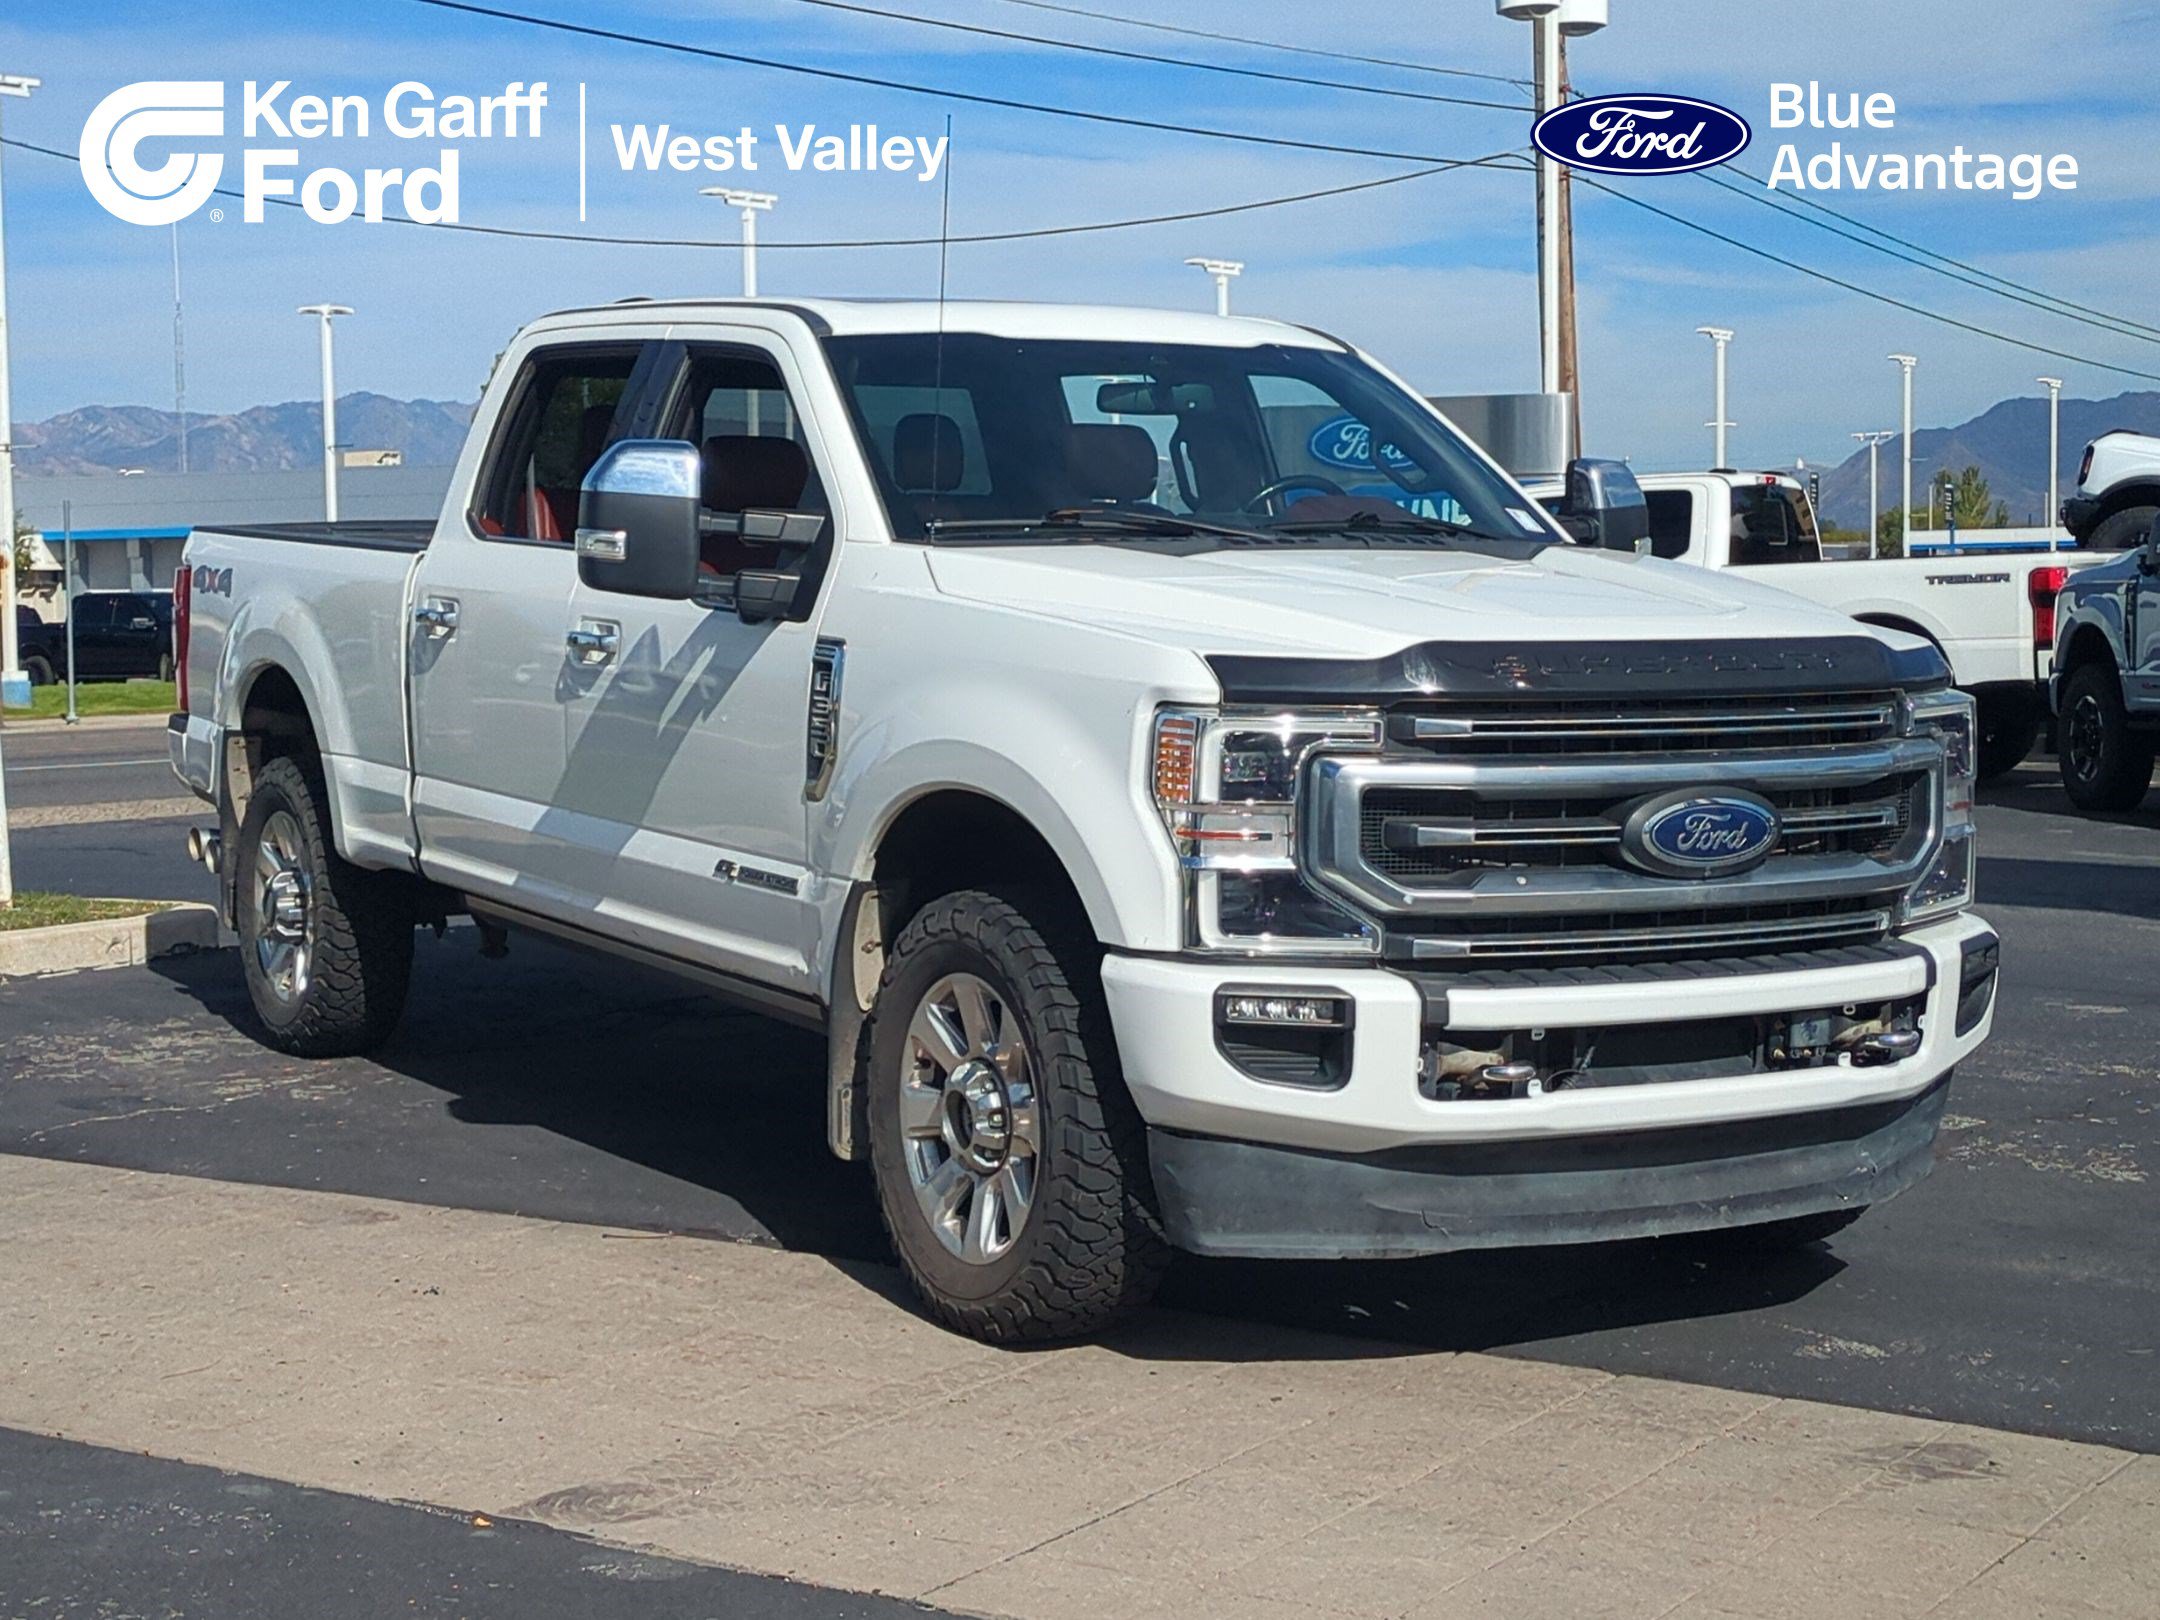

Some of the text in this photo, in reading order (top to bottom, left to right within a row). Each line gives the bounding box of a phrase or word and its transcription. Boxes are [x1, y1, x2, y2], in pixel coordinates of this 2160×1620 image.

[1333, 424, 1405, 460] Fod
[1925, 573, 2010, 585] TREMOR
[1676, 812, 1750, 852] Ford
